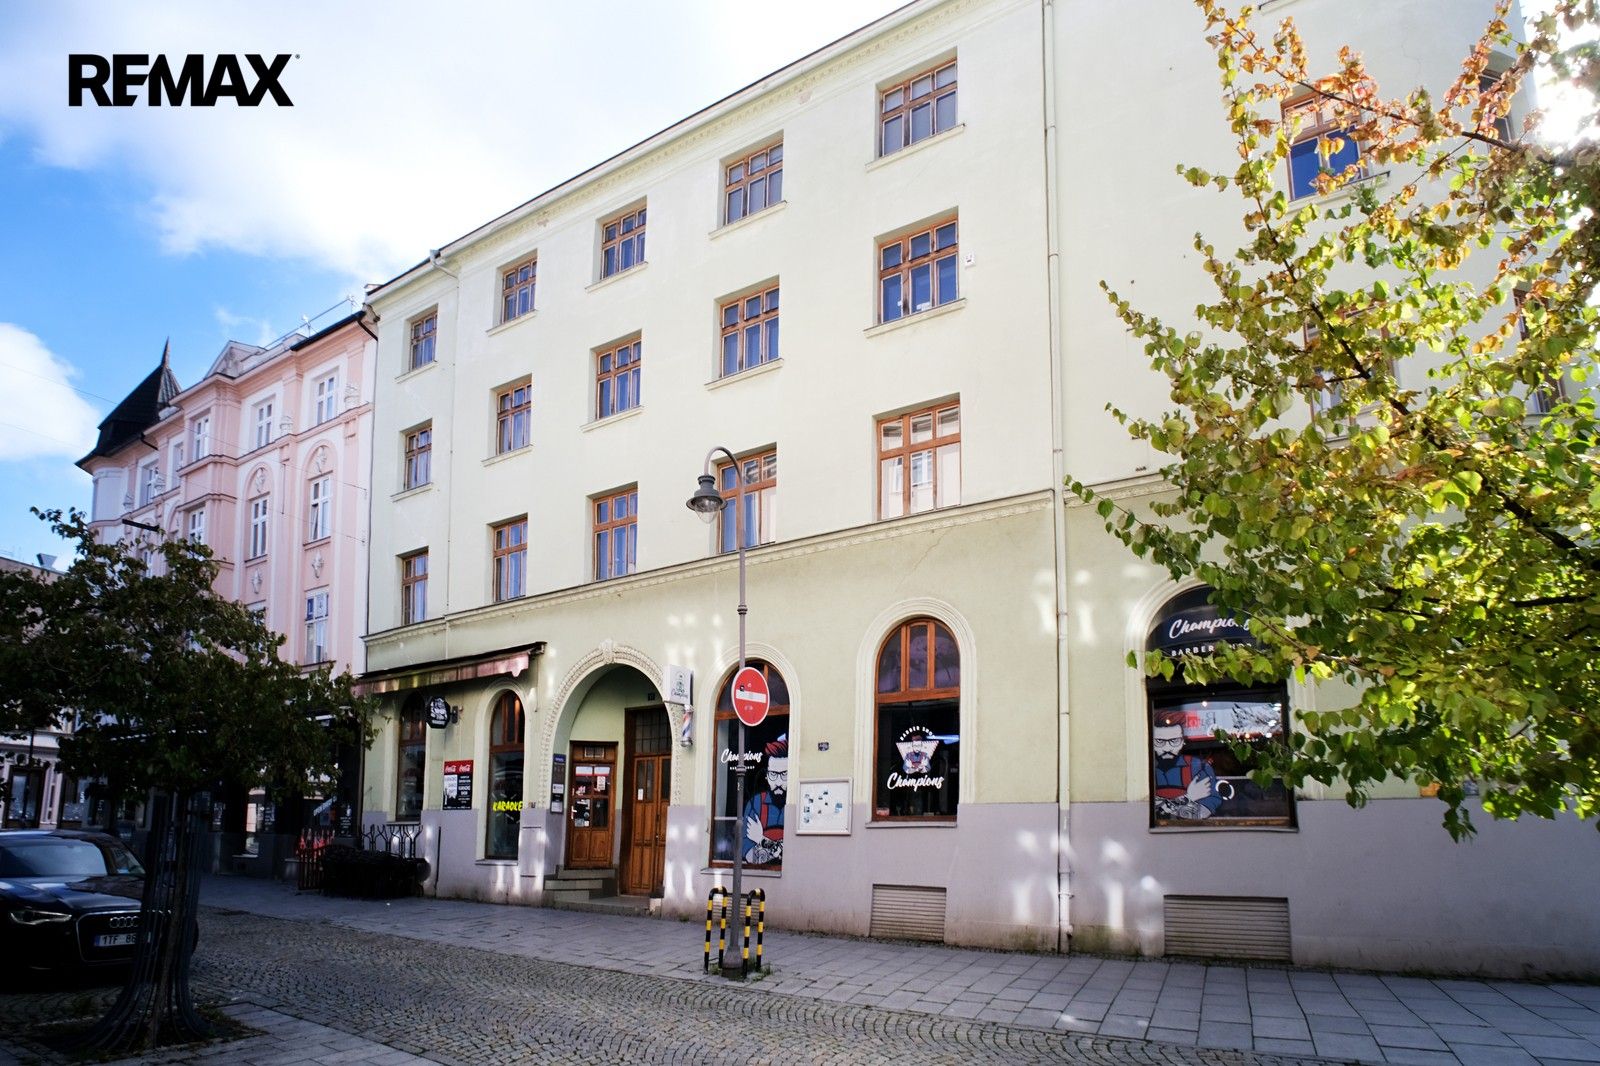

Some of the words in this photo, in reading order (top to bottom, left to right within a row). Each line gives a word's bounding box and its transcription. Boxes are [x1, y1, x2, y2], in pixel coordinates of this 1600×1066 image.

[1169, 618, 1250, 638] Champios
[1171, 645, 1215, 657] BARBER
[887, 772, 944, 792] Champions
[493, 801, 523, 811] KARAOKE
[103, 935, 119, 945] 1TF
